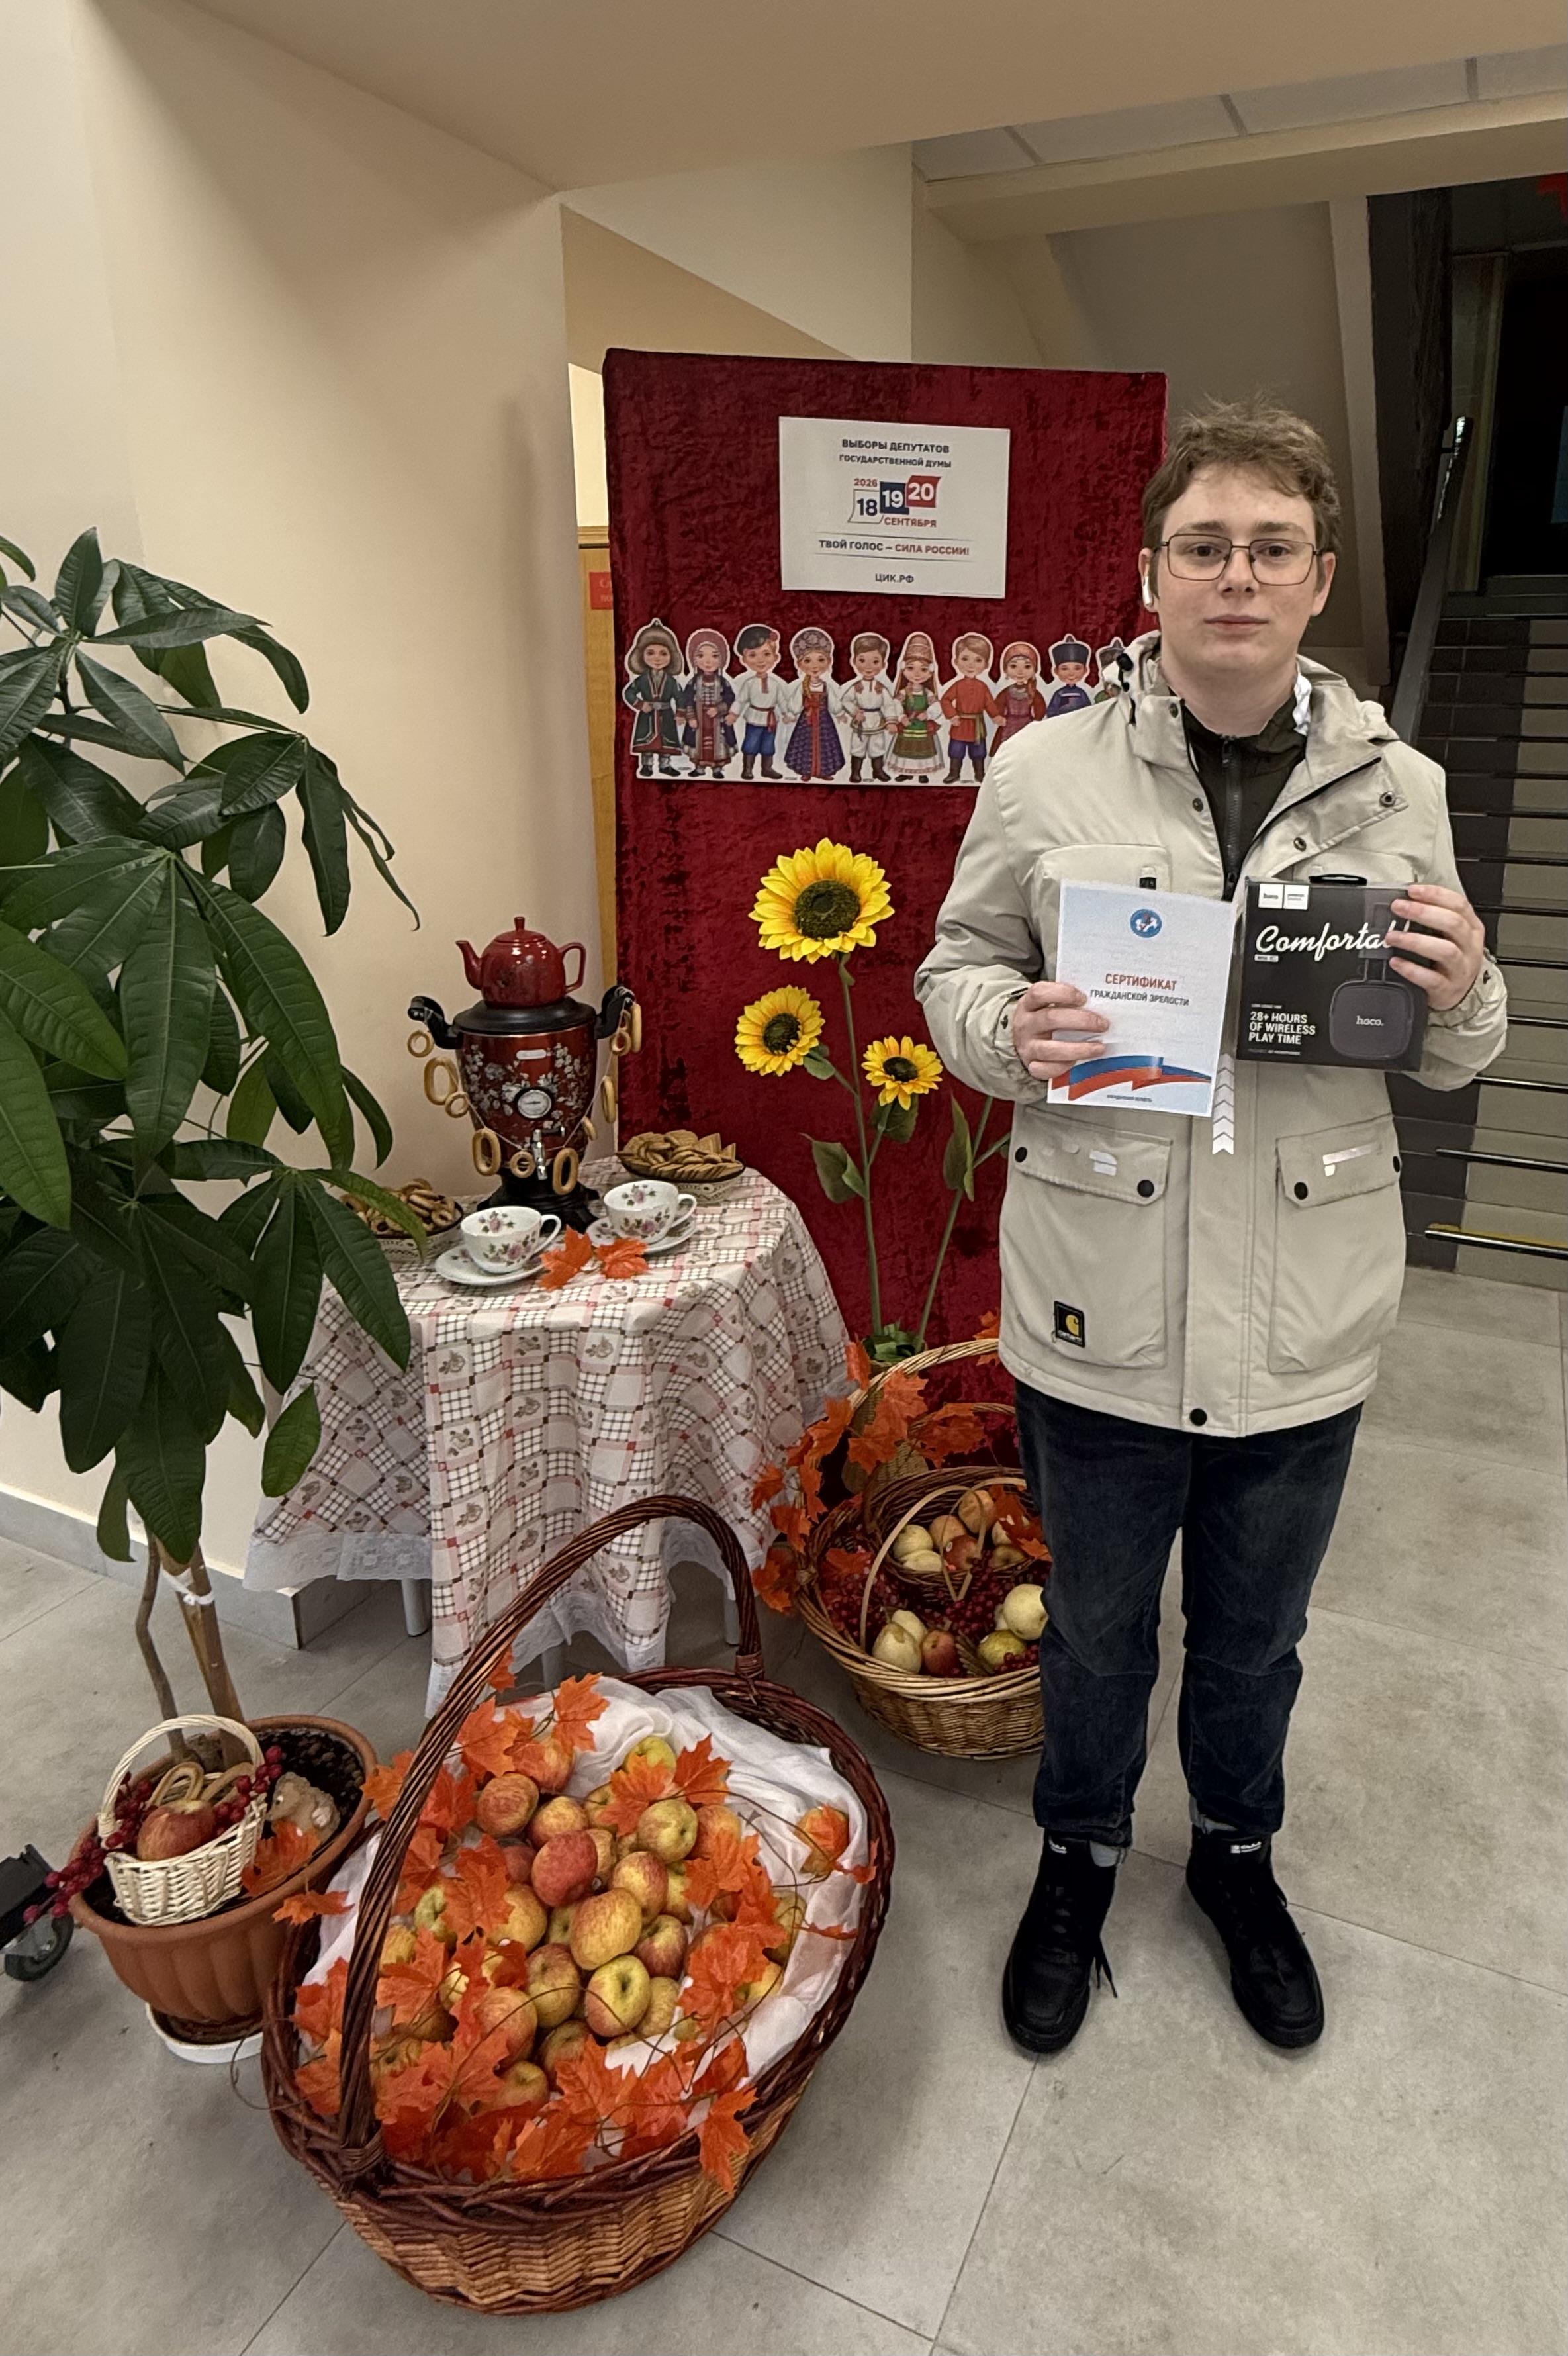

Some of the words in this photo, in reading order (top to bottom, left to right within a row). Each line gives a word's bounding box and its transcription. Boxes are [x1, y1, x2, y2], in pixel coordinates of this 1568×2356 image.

[842, 439, 887, 449] ВЫБОРЫ
[890, 442, 950, 453] ДЕПУТАТОВ
[839, 454, 924, 466] ГОСУДАРСТВЕННОЙ
[925, 459, 952, 468] ДУМЫ
[853, 478, 878, 487] 2026
[856, 498, 878, 516] 18
[882, 489, 904, 508] 19
[907, 482, 935, 501] 20
[884, 516, 937, 528] СЕНТЯБРЯ
[819, 539, 847, 549] ТВОЙ
[849, 541, 884, 551] ГОЛОС
[895, 543, 923, 553] СИЛА
[925, 545, 969, 556] РОССИИ!
[874, 573, 915, 584] ЦИК.РФ
[1255, 919, 1410, 962] Comforta
[1105, 973, 1178, 991] СЕРТИФИКАТ
[1089, 989, 1148, 1002] ГРАЖДАНСКОЙ
[1149, 994, 1190, 1006] ЗРЕЛОСТИ
[1250, 1011, 1269, 1021] 28+
[1271, 1012, 1308, 1024] HOURS
[1356, 1015, 1385, 1027] hoco.
[1249, 1021, 1264, 1031] OF
[1265, 1023, 1316, 1035] WIRELESS
[1248, 1032, 1275, 1043] PLAY
[1277, 1034, 1302, 1045] TIME
